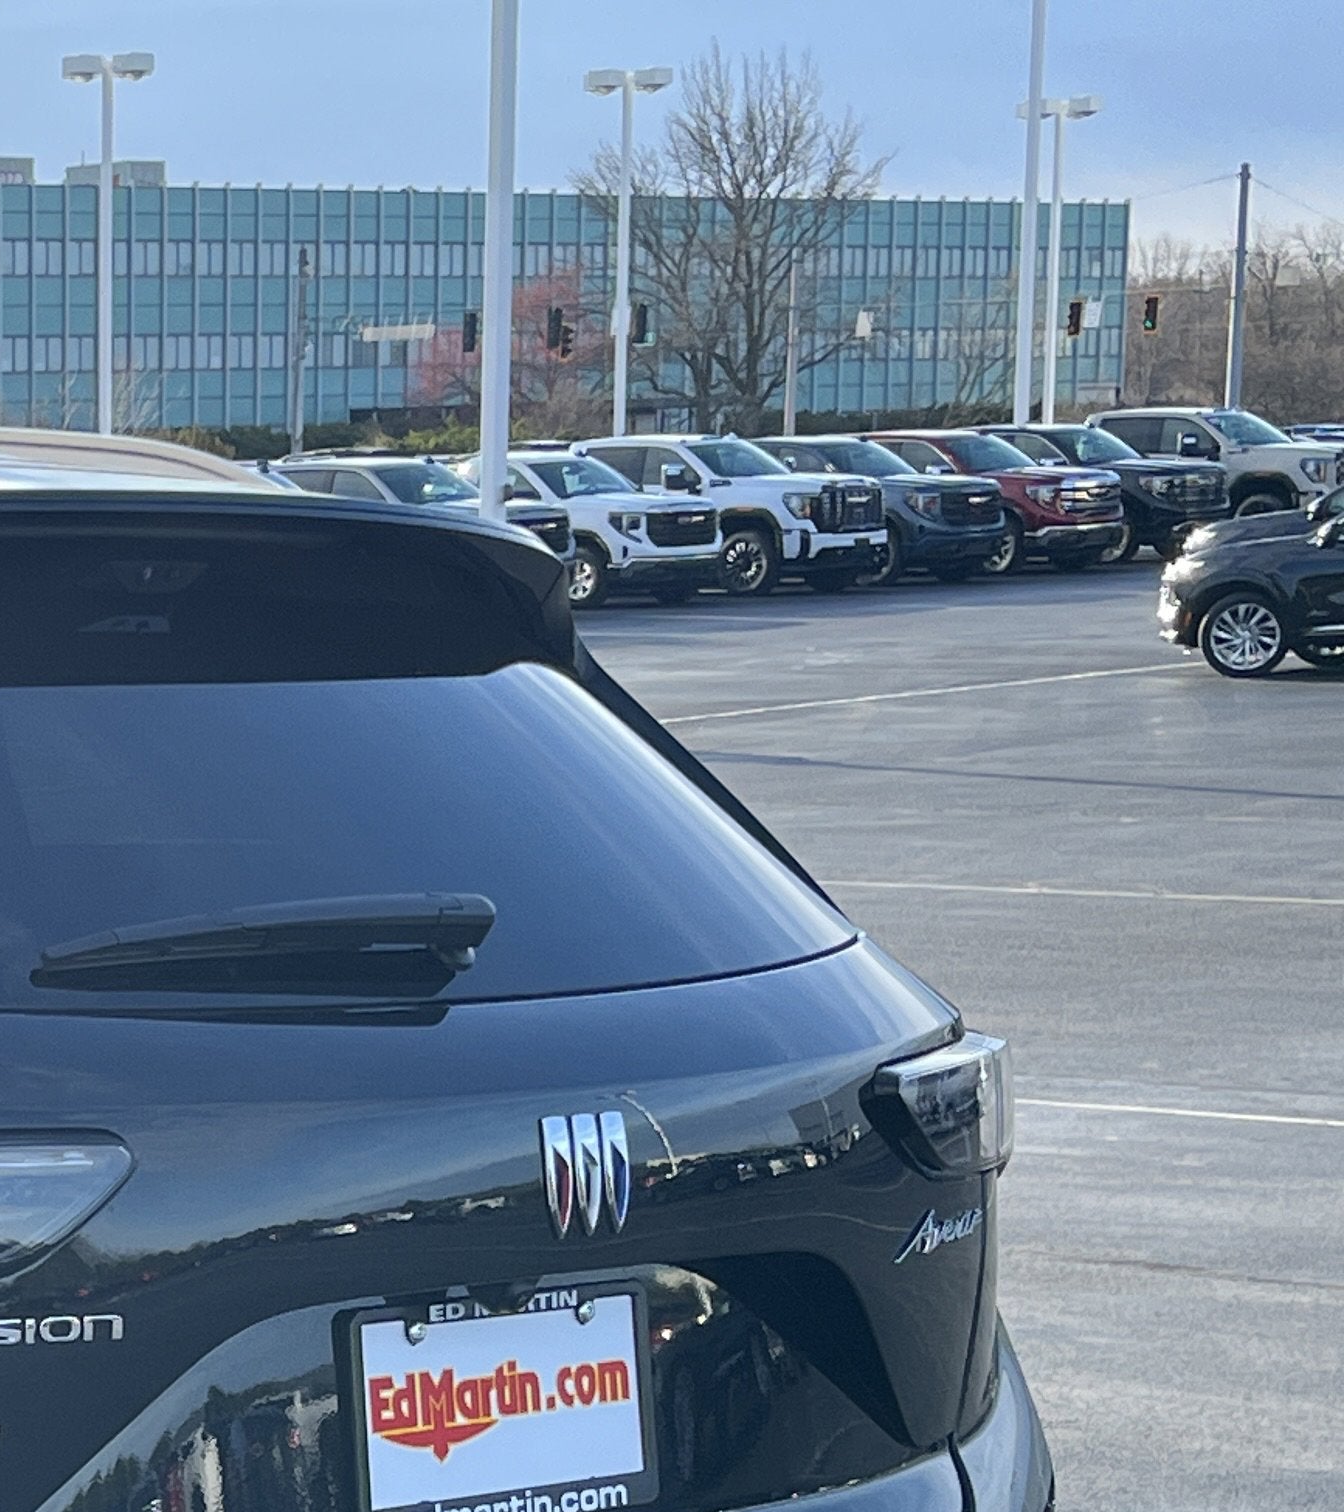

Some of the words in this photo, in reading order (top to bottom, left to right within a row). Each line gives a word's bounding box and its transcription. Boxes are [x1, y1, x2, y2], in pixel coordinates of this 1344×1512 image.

[428, 1303, 466, 1323] ED
[474, 1289, 578, 1318] MTIN
[368, 1360, 630, 1436] EdMartin.com
